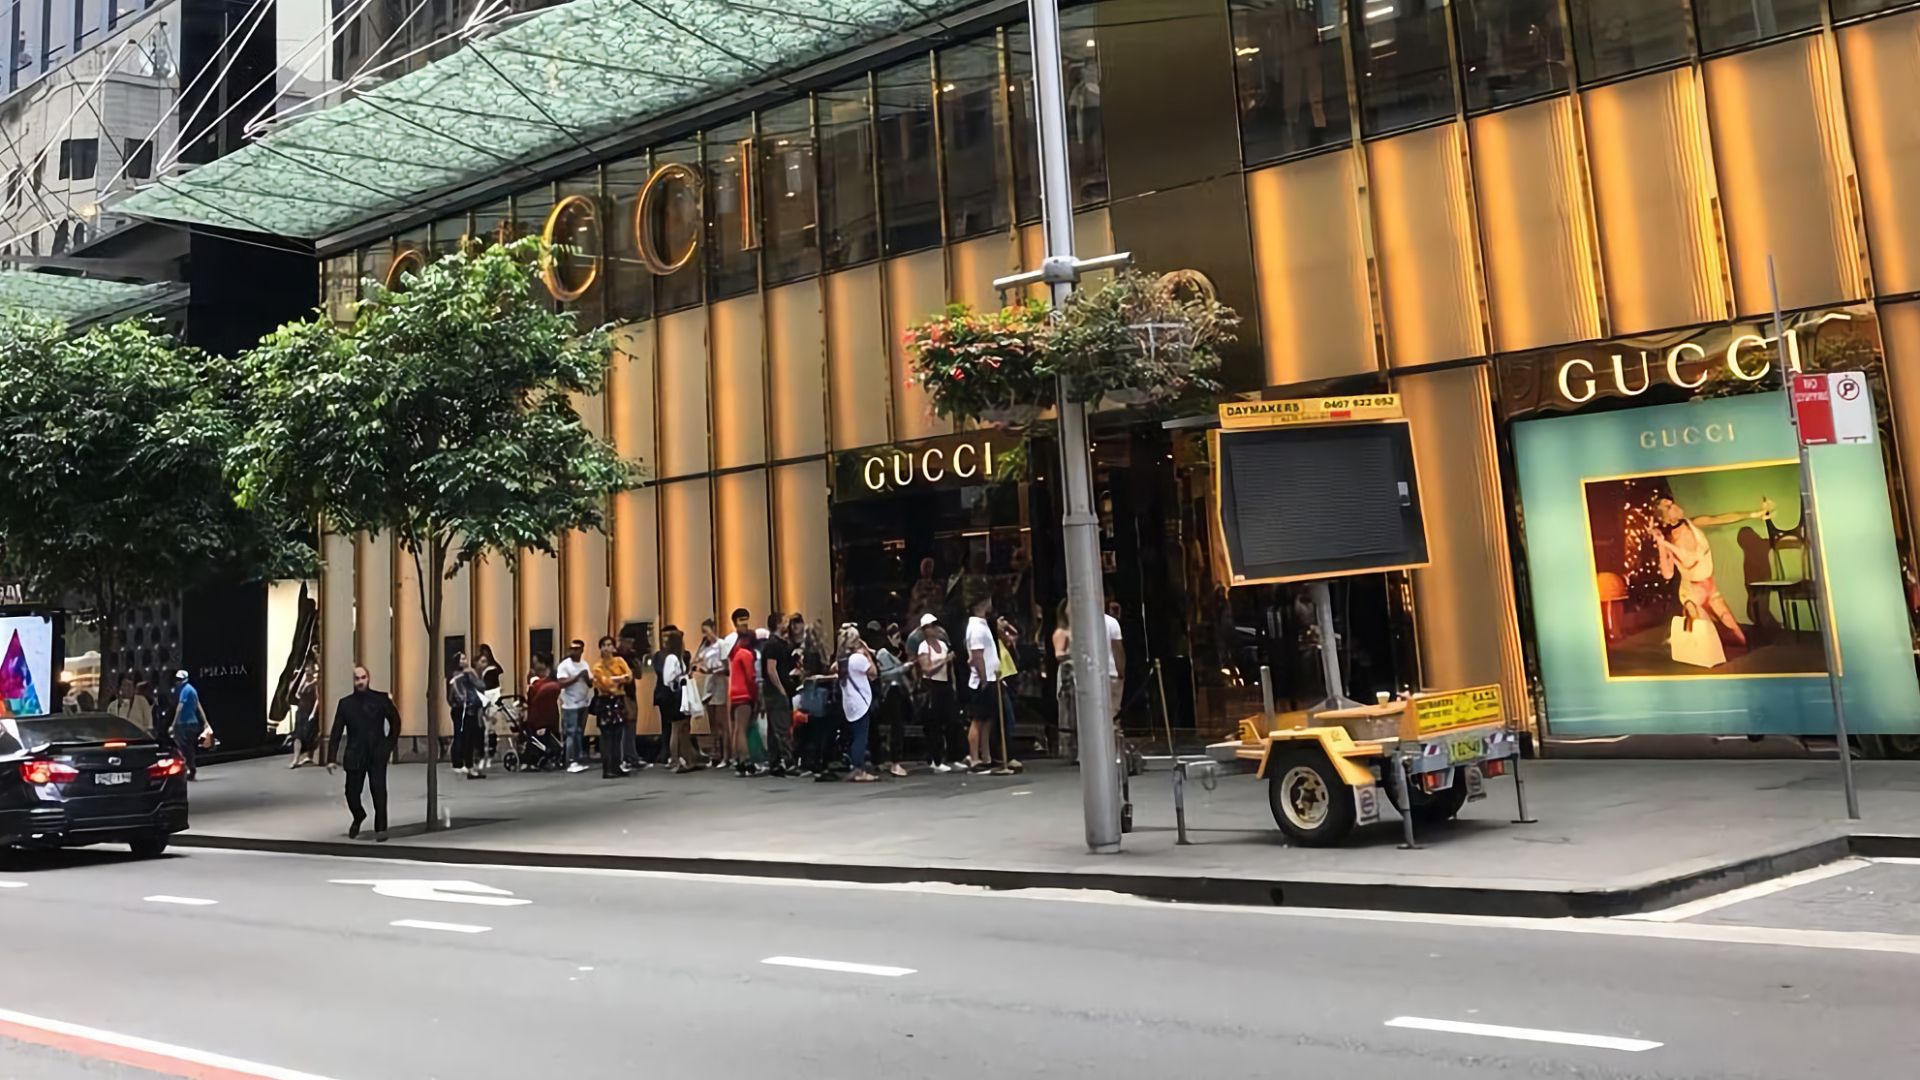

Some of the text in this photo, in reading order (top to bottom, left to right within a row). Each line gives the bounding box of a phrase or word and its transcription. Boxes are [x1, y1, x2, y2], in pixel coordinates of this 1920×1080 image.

[382, 138, 761, 300] CCI
[1558, 330, 1802, 402] GUCCI
[1227, 402, 1300, 416] DAYMAKERS
[1640, 423, 1734, 449] GUCCI
[864, 442, 992, 490] GUCCI
